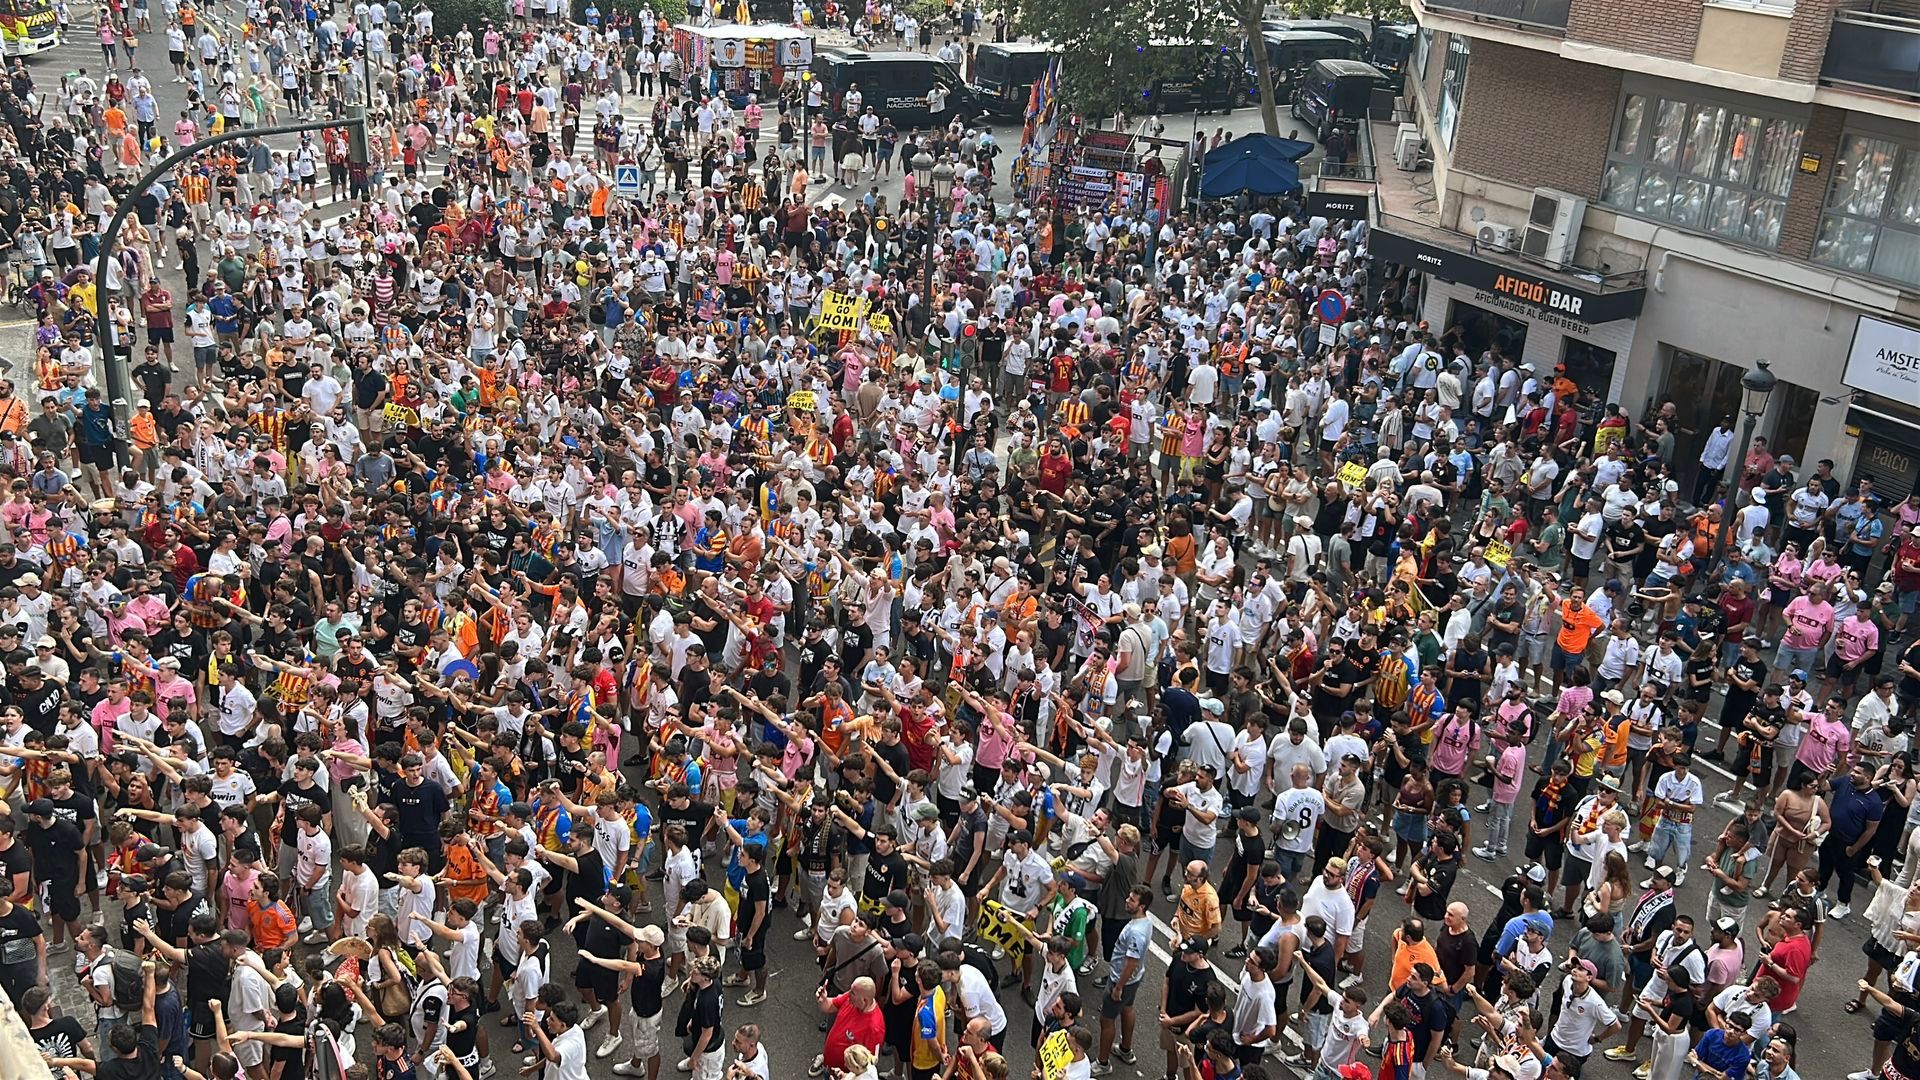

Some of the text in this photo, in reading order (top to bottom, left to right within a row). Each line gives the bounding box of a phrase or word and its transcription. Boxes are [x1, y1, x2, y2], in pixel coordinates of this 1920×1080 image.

[886, 102, 928, 110] NACIONAL
[1325, 203, 1355, 212] MORITZ
[1417, 253, 1442, 266] MORITZ
[832, 294, 856, 307] LIM
[1549, 290, 1583, 315] BAR
[836, 305, 850, 315] GO
[1474, 291, 1590, 336] AFICIONADOS AL BUEN BEBER
[390, 405, 408, 415] LIM
[789, 401, 813, 409] HOME
[211, 792, 237, 802] bwin
[1299, 807, 1312, 830] 8
[1056, 1032, 1068, 1057] LIM
